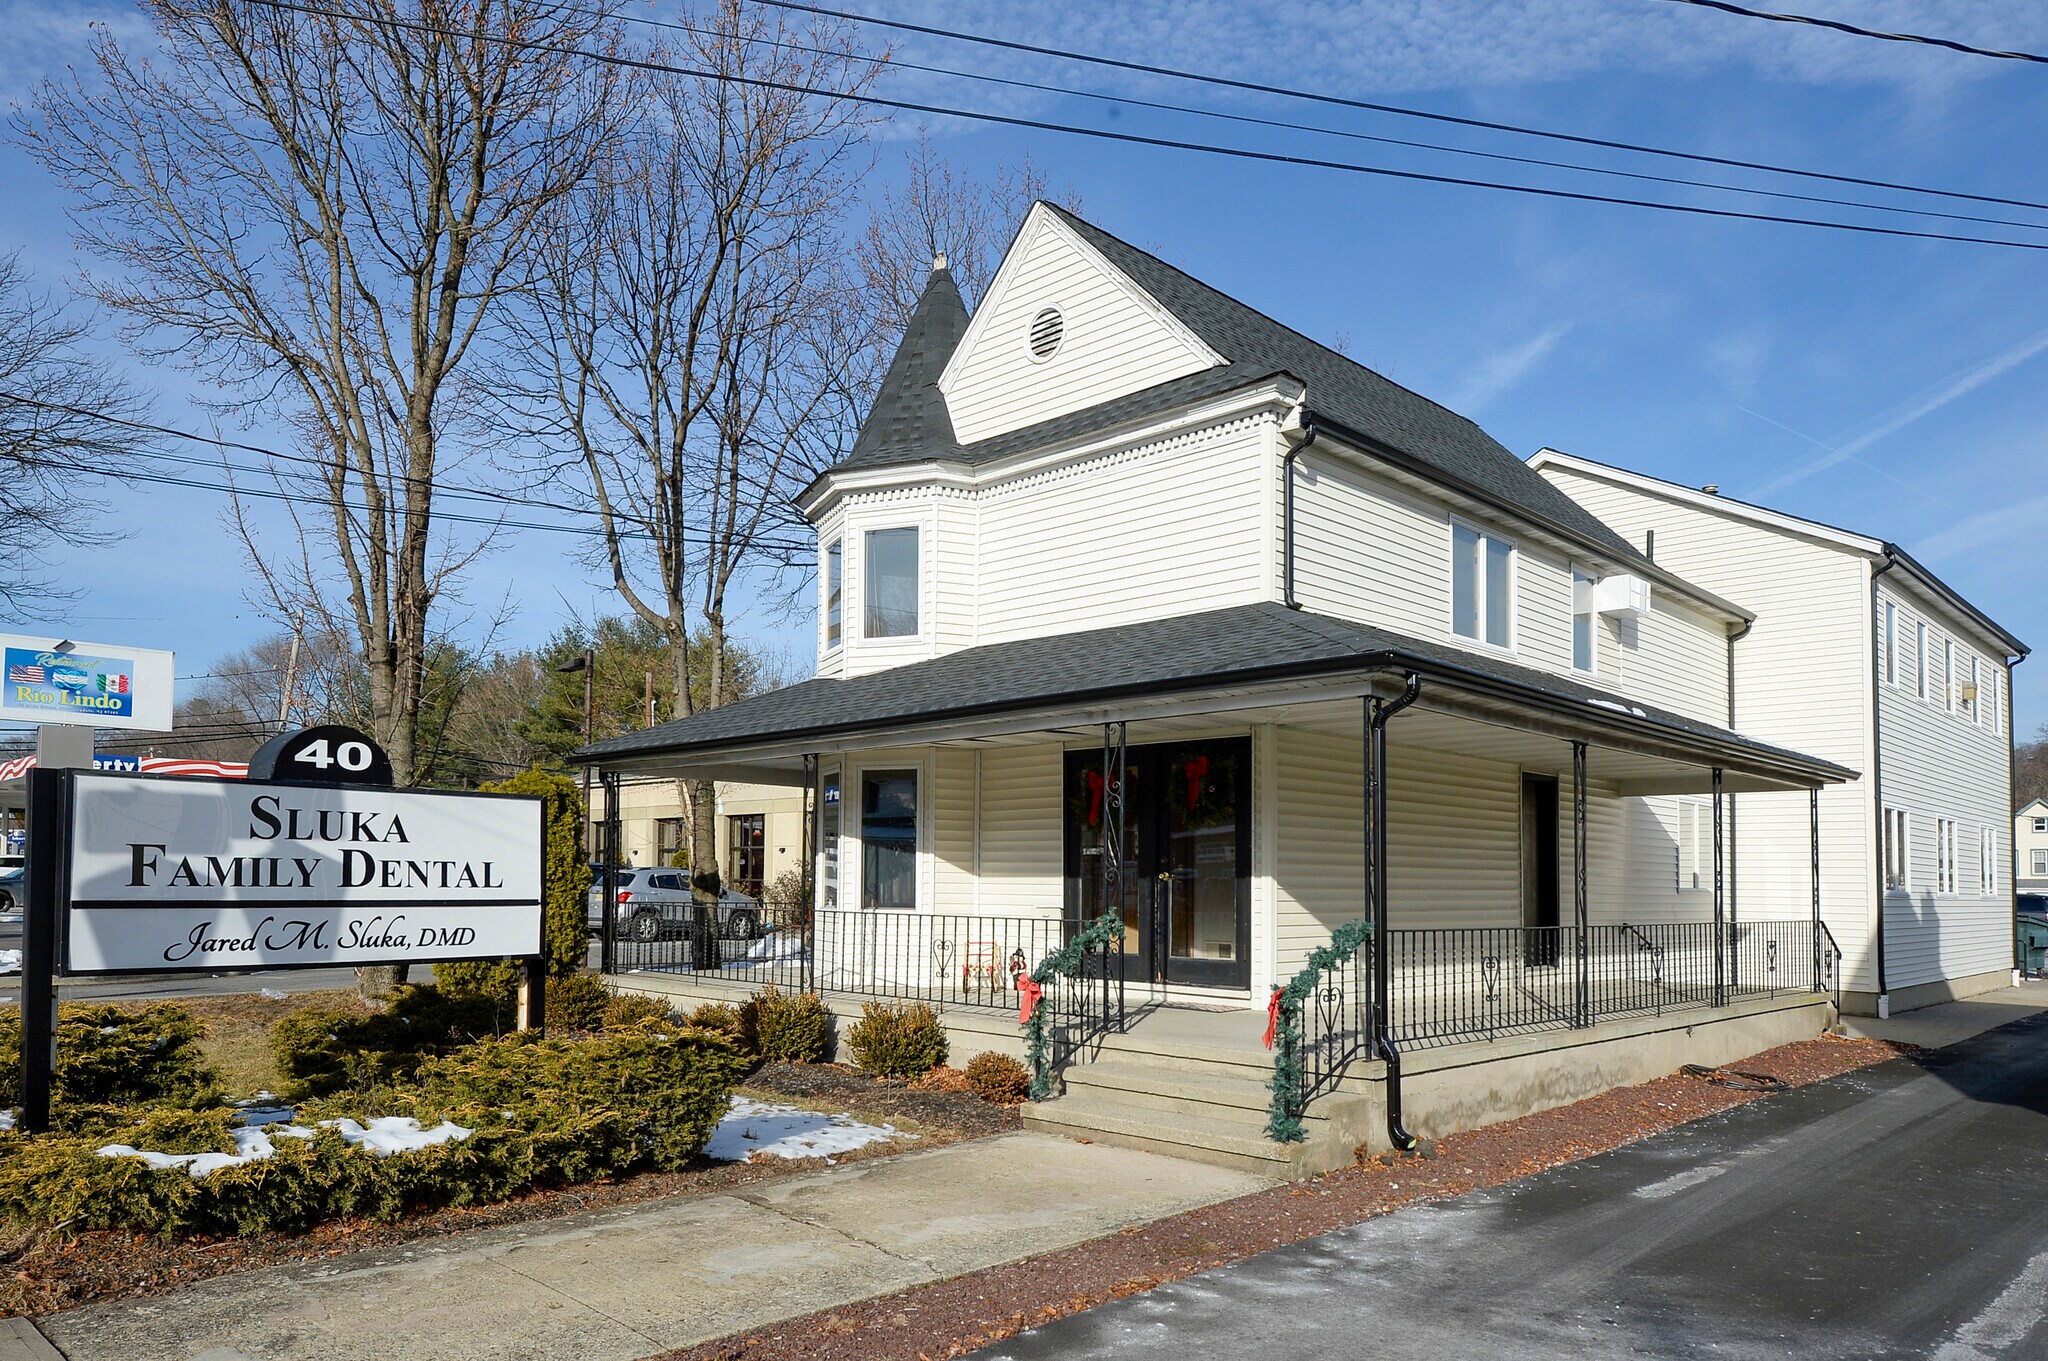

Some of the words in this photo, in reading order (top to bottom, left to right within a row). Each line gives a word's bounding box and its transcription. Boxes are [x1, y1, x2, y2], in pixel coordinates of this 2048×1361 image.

[16, 685, 55, 704] Río
[60, 690, 122, 710] Lindo
[93, 759, 136, 771] erty
[294, 739, 373, 772] 40
[249, 795, 410, 843] SLUKA
[124, 843, 321, 888] FAMILY
[337, 849, 504, 889] DENTAL
[163, 915, 275, 962] Jared
[265, 920, 329, 950] M.
[338, 916, 411, 952] Sluka,
[416, 927, 476, 948] DMD
